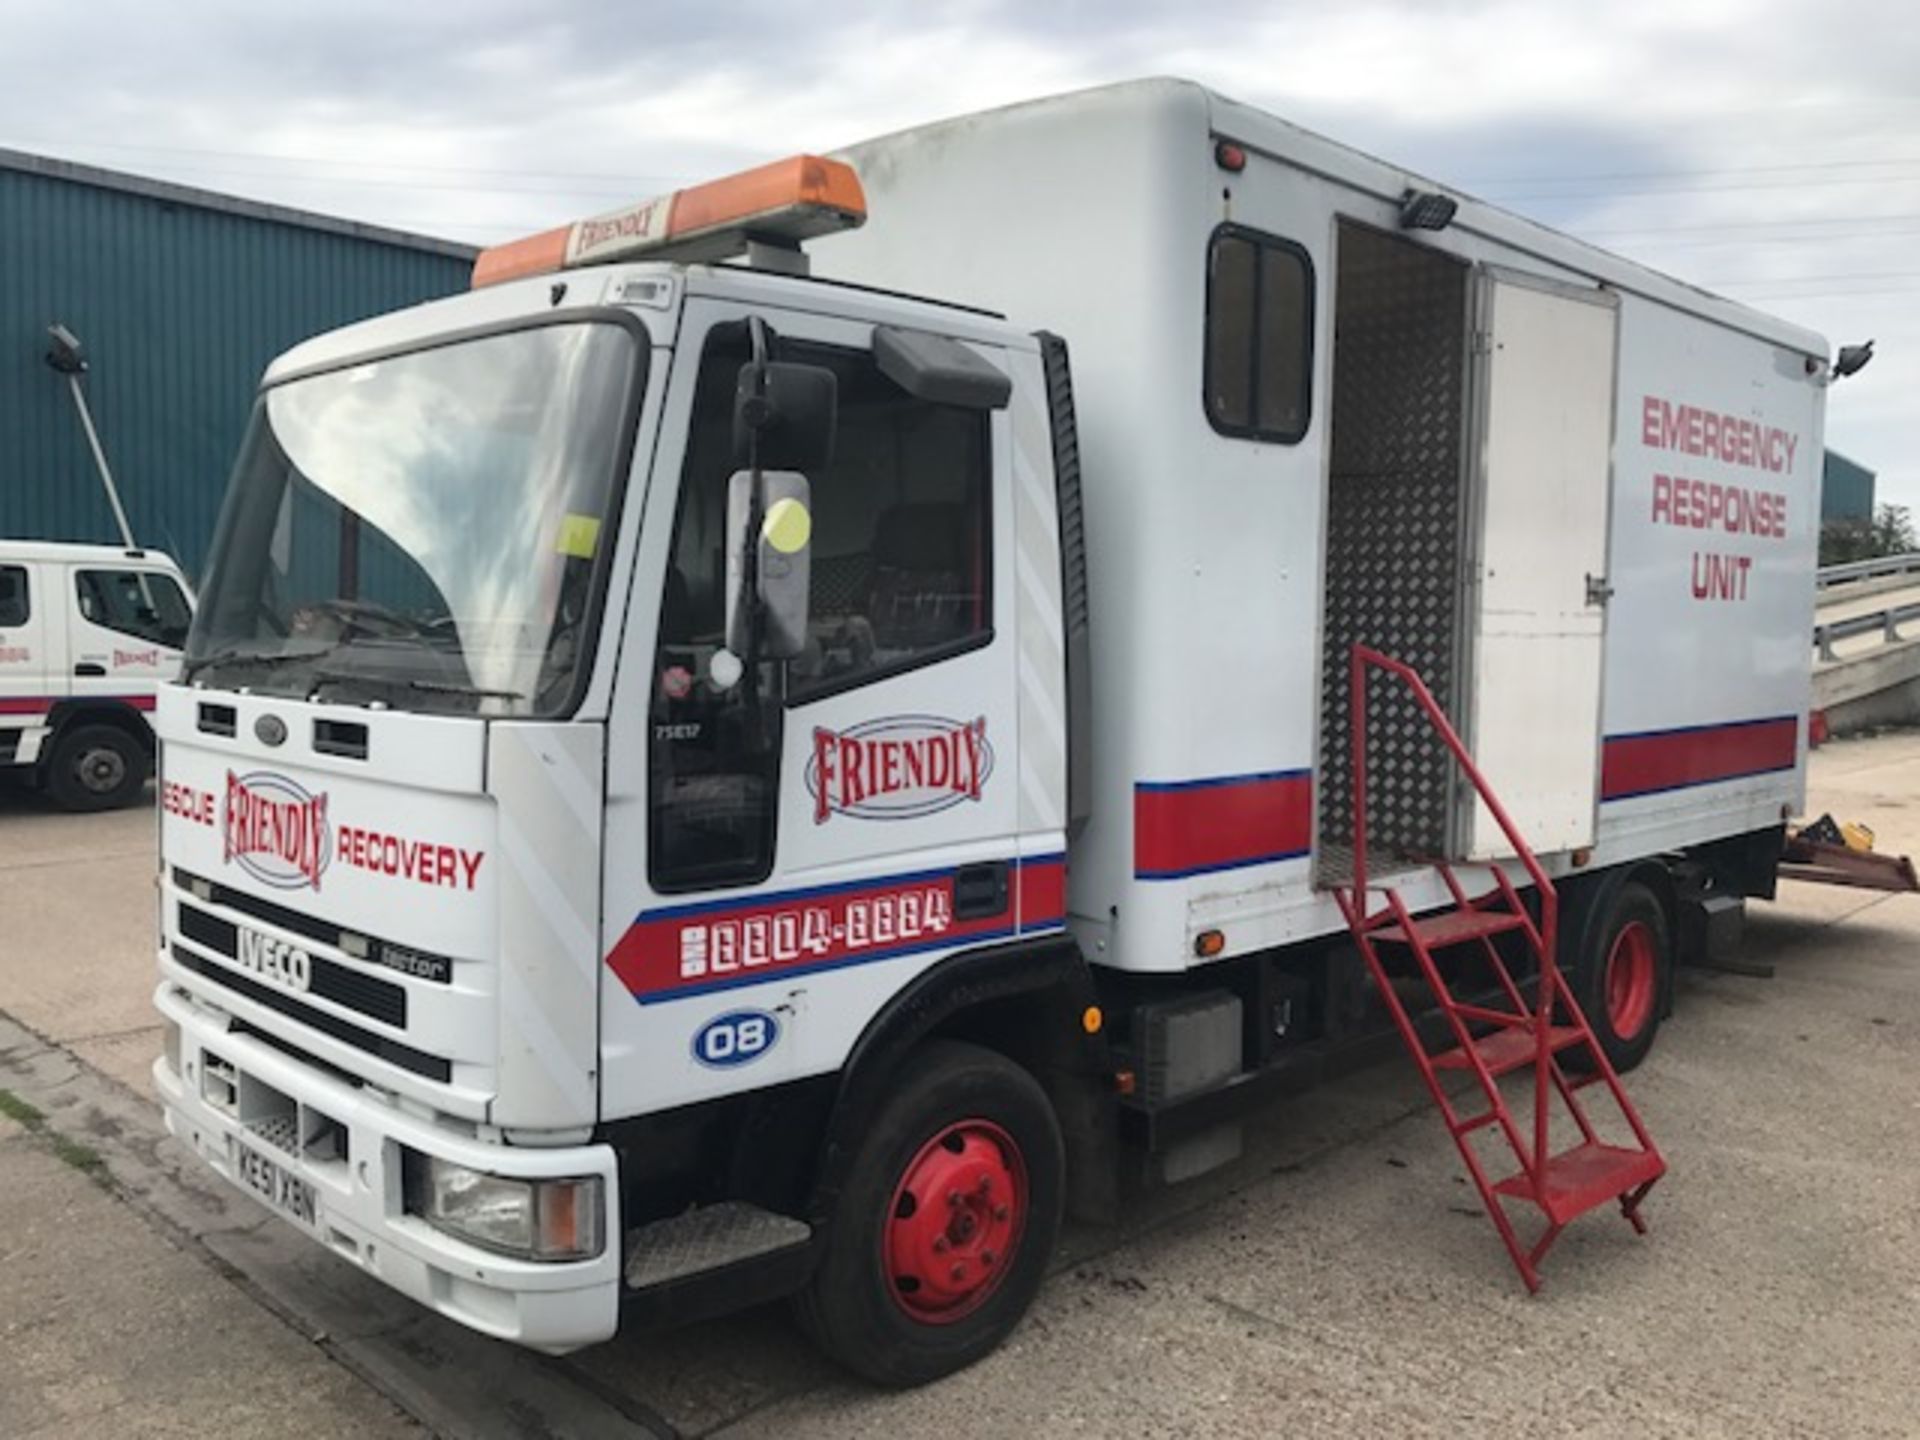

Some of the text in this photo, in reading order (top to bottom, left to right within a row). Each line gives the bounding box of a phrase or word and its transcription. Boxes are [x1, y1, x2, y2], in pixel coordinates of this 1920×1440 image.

[576, 203, 654, 256] FRIENDLY
[1642, 395, 1798, 475] EMERGENCY
[1652, 473, 1786, 538] RESPONSE
[1692, 552, 1751, 601] UNIT
[813, 715, 986, 826] FRIENDLY
[162, 768, 485, 892] ESCUE FRIENDLY RECOVERY
[238, 925, 311, 993] IVECO
[705, 1019, 766, 1059] 08
